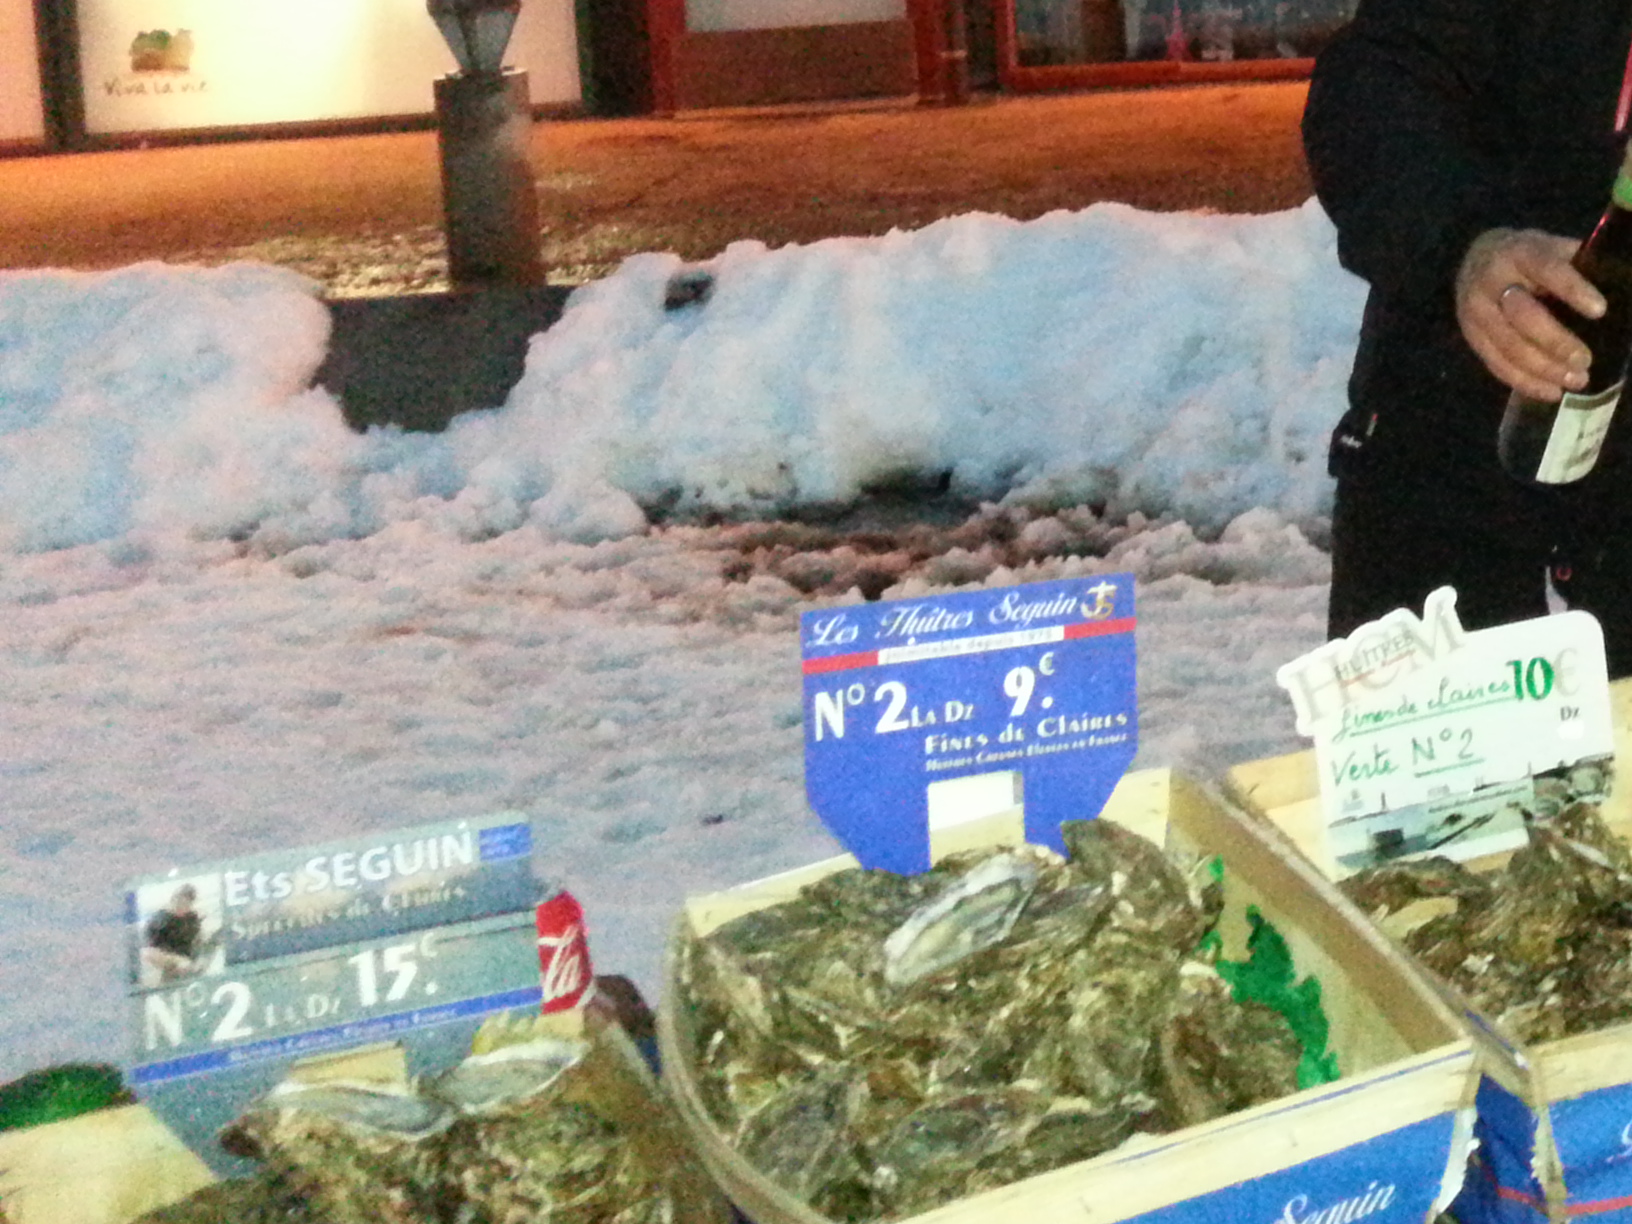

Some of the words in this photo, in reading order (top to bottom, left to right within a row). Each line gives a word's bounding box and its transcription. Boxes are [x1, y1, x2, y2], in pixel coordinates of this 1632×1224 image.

[805, 613, 859, 648] Les
[989, 589, 1078, 630] Seguin
[224, 870, 293, 907] Ets
[304, 831, 474, 893] SEGUIN
